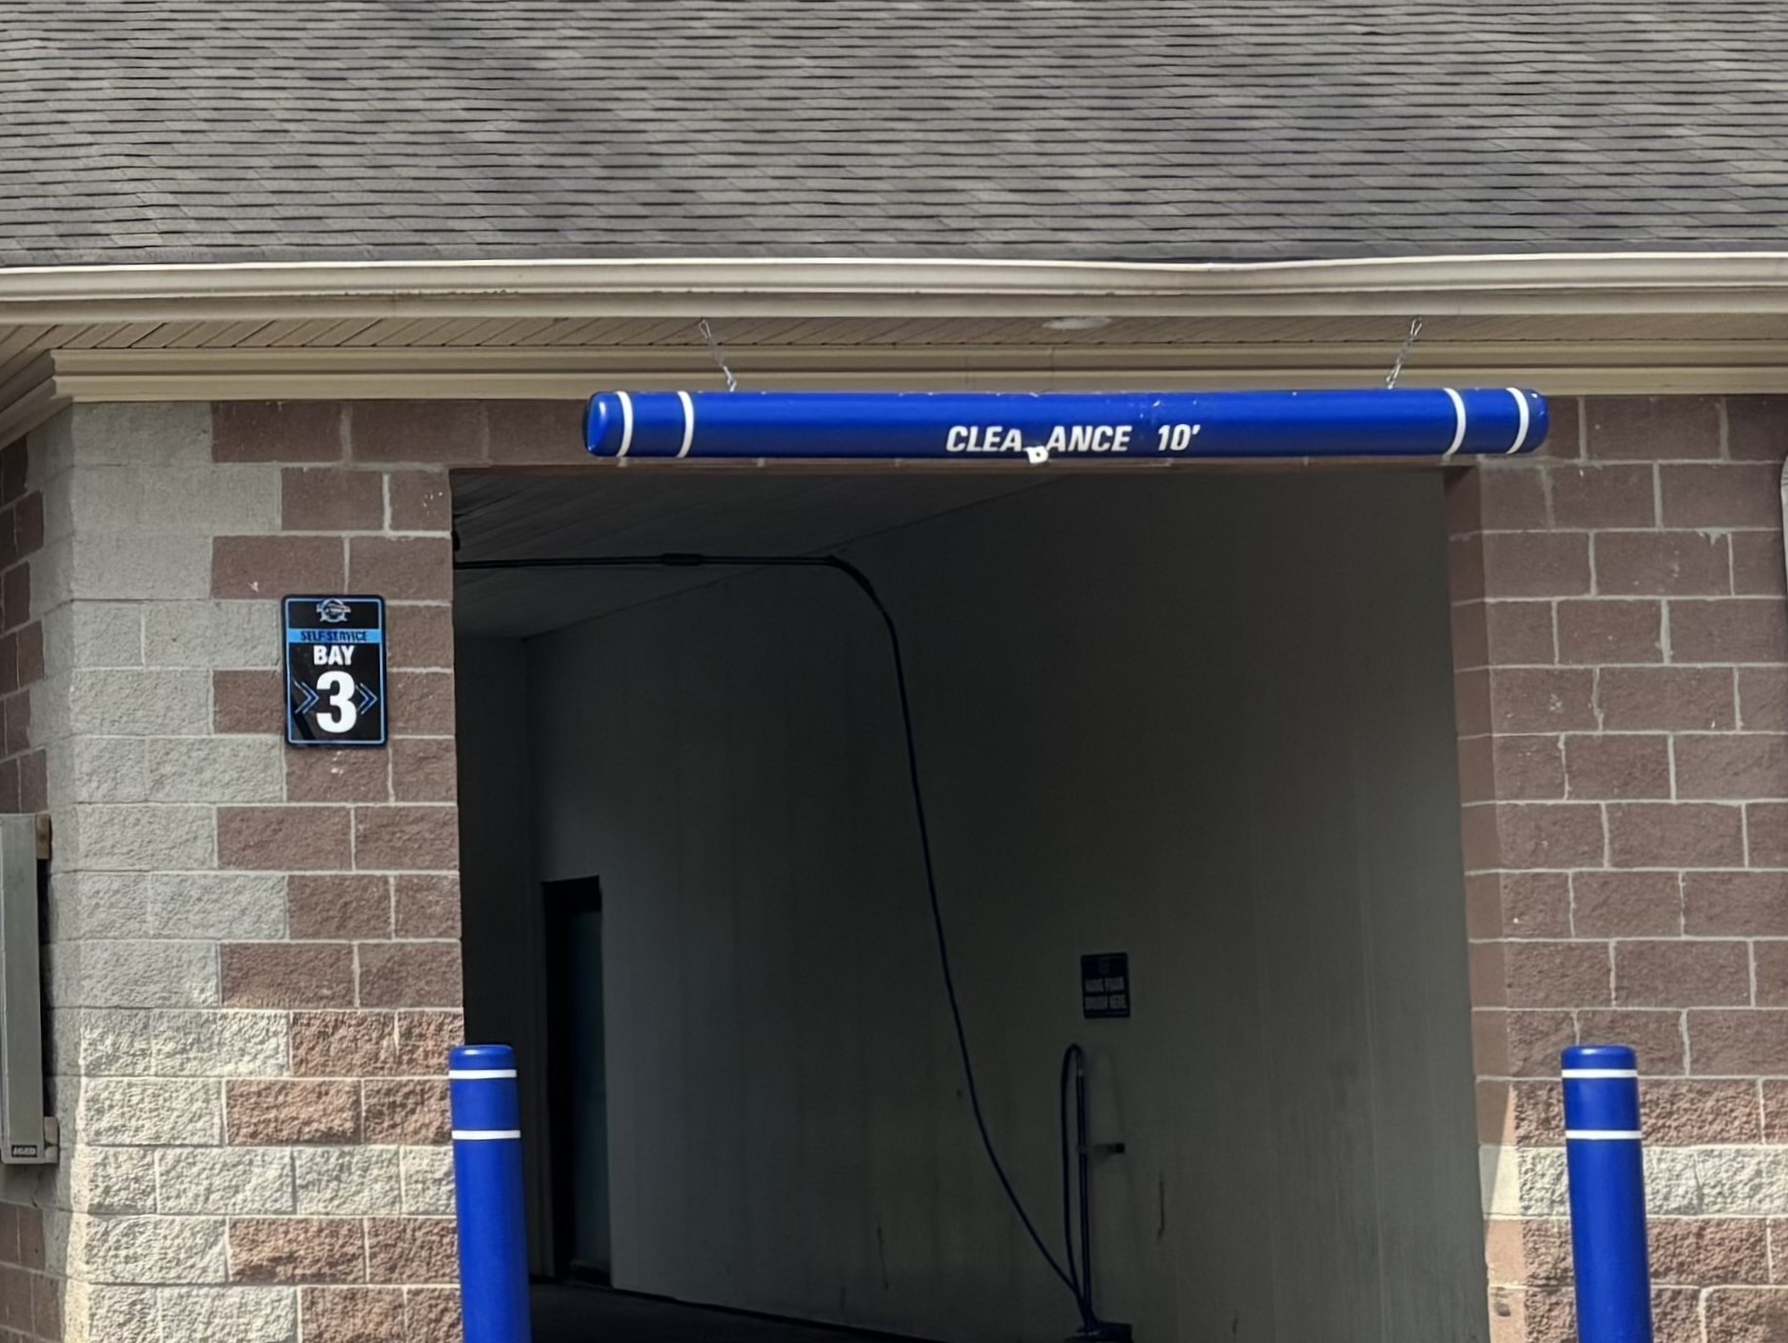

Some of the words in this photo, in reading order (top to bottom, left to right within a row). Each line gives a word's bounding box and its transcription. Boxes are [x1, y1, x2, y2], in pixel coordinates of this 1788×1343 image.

[1157, 424, 1201, 452] 10'
[313, 645, 355, 665] BAY
[316, 670, 357, 733] 3
